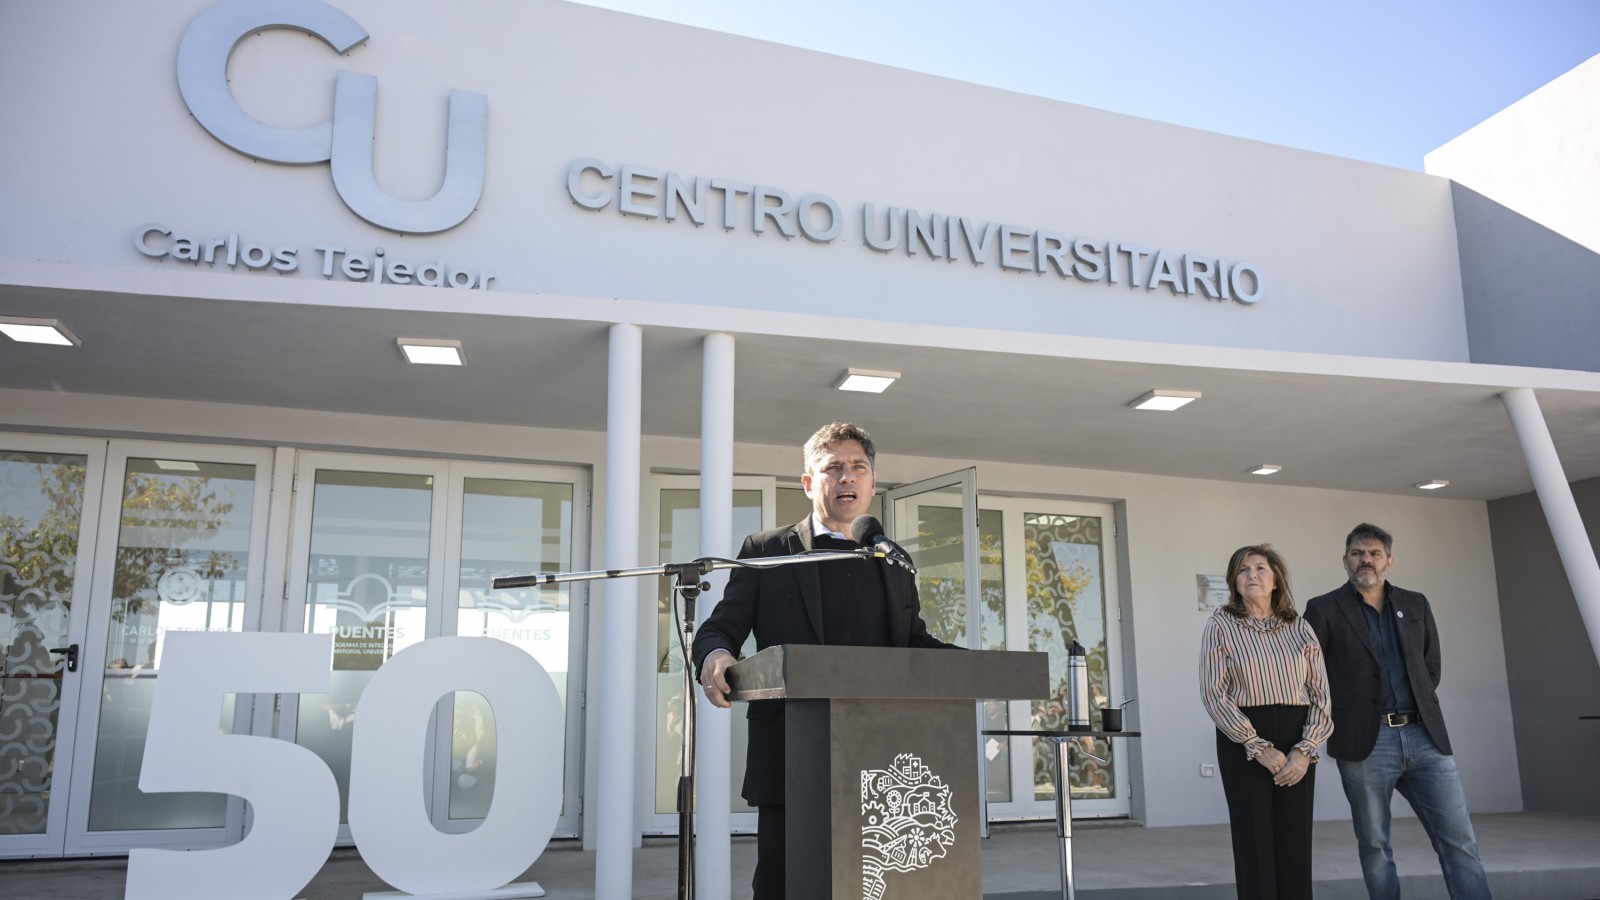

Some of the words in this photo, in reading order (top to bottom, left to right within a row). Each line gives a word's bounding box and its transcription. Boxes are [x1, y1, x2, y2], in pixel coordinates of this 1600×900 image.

[177, 0, 488, 234] CU
[133, 223, 299, 273] Carlos
[314, 244, 496, 290] Tejedor
[567, 158, 843, 244] CENTRO
[863, 202, 1266, 306] UNIVERSITARIO
[329, 625, 405, 639] PUENTES
[125, 631, 565, 899] 50
